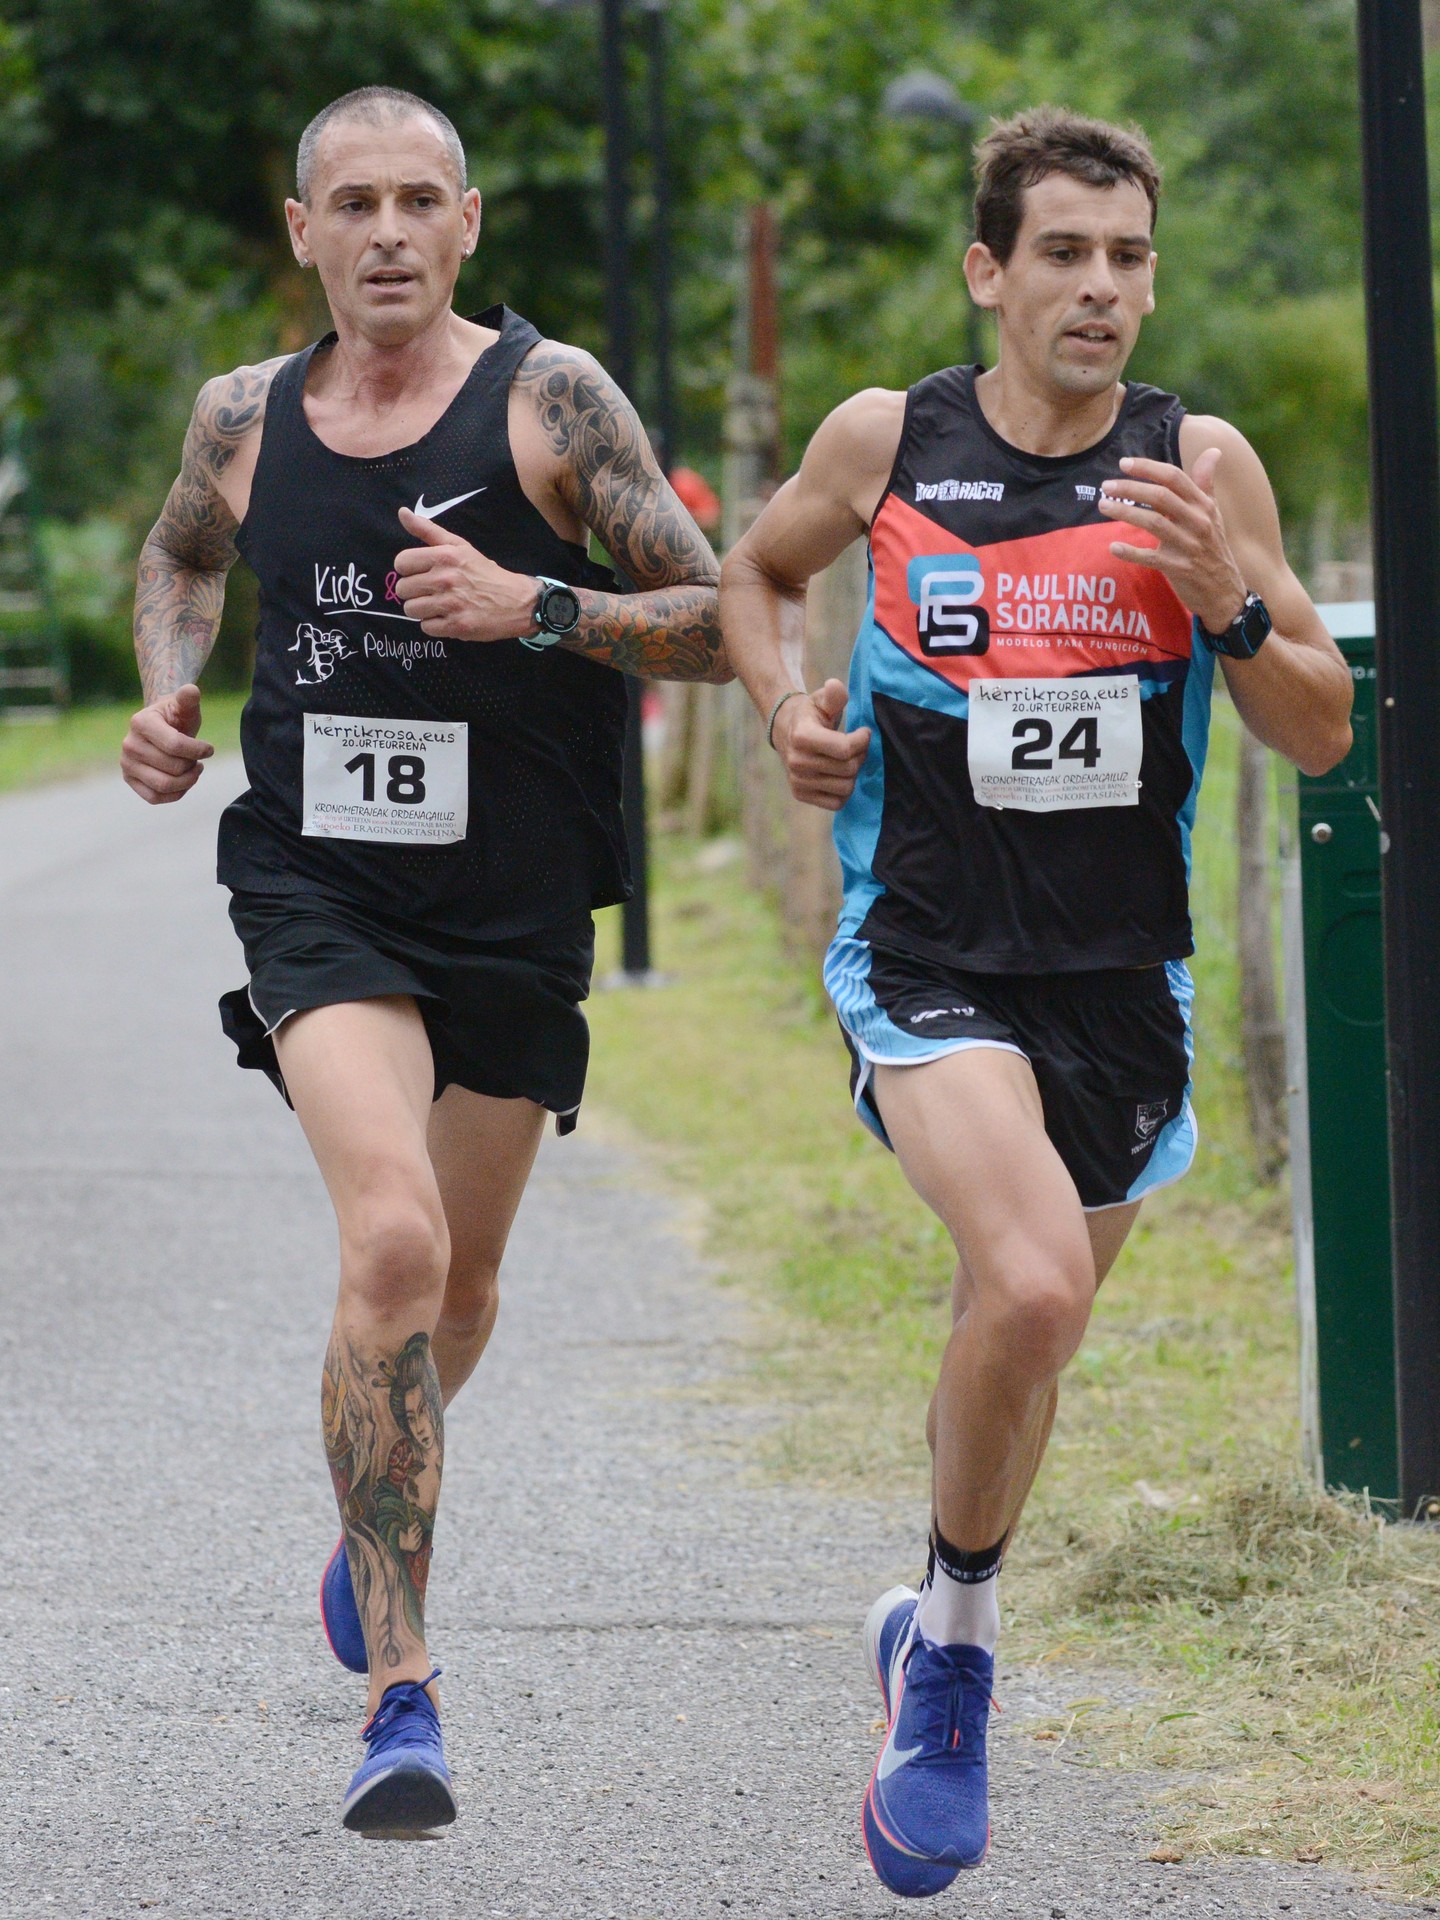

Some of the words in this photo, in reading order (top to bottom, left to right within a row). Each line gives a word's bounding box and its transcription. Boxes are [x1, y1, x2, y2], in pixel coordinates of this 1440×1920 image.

[958, 480, 1005, 501] RACER
[315, 562, 374, 608] Kids
[996, 572, 1116, 604] PAULINO
[996, 602, 1151, 640] SORARRAIN
[996, 638, 1051, 648] MODELOS
[1057, 638, 1084, 649] PARA
[1089, 639, 1149, 655] FUNDICIÓN
[979, 685, 1129, 702] herrikrosa.eus
[313, 721, 456, 744] herrikrosa.eus
[1011, 717, 1102, 770] 24
[343, 752, 426, 805] 18
[1025, 789, 1128, 804] ERAGINKORTASUNA
[314, 803, 389, 818] KRONOMETRAJEAK
[391, 809, 456, 821] ORDENAGAILUZ
[353, 824, 457, 837] ERAGINKORTASUNA
